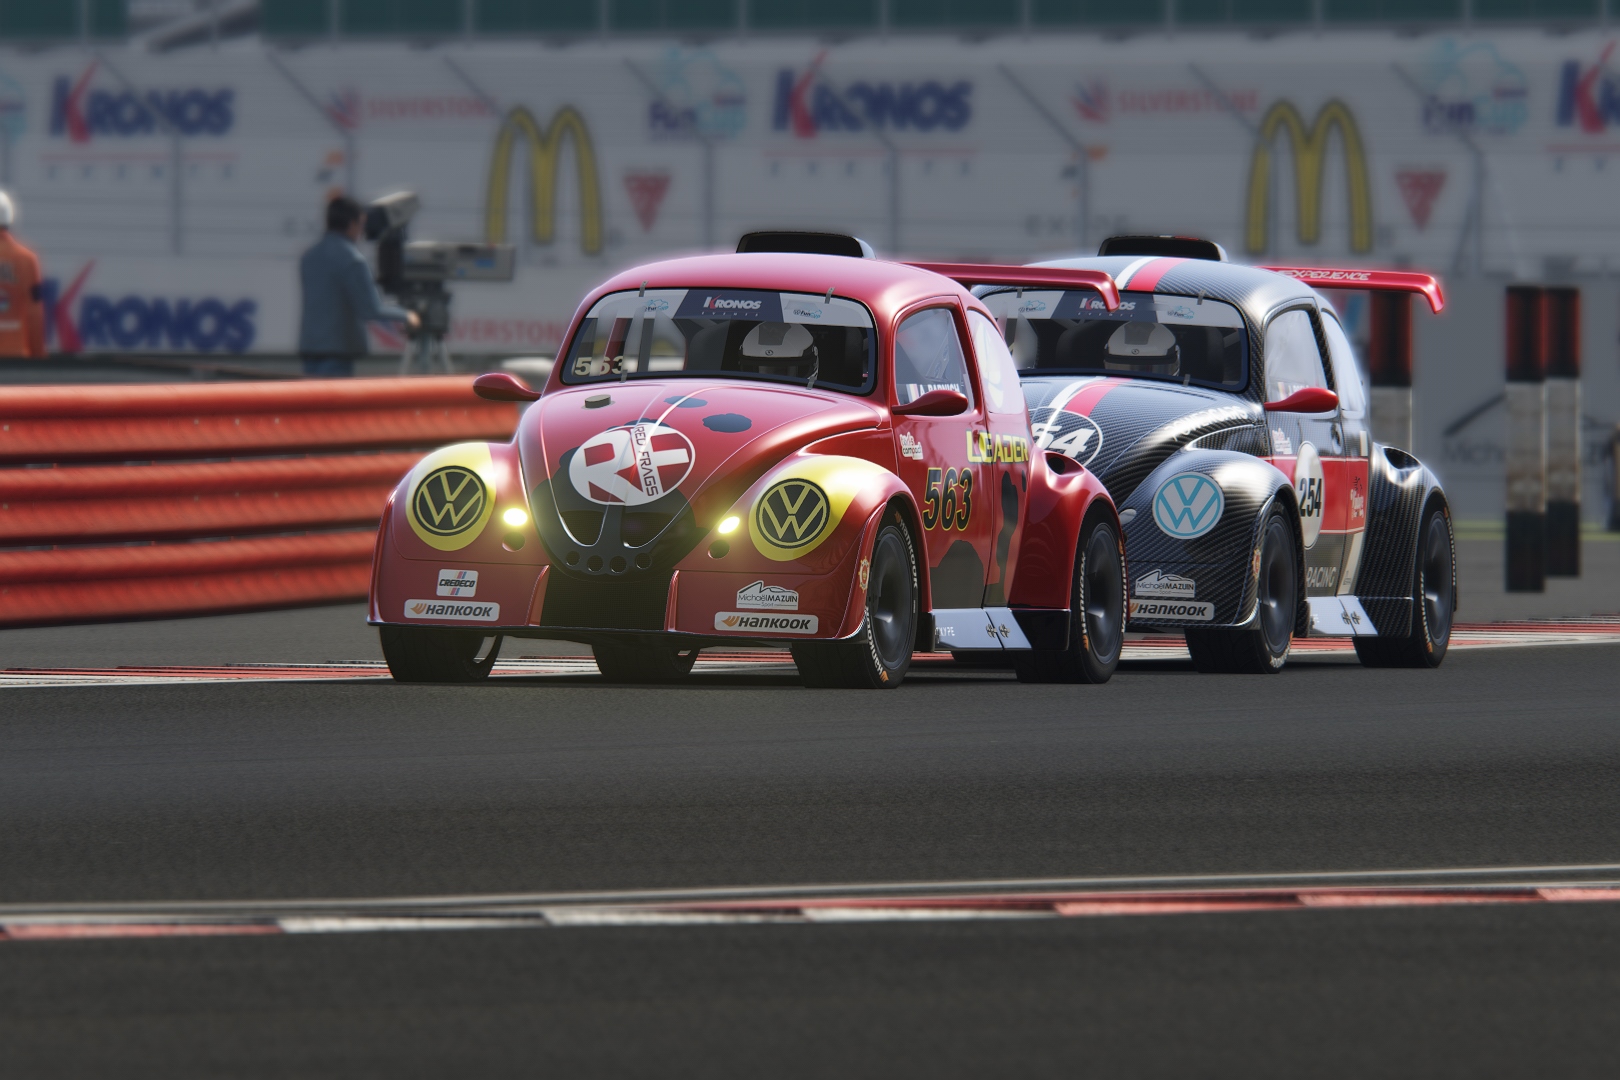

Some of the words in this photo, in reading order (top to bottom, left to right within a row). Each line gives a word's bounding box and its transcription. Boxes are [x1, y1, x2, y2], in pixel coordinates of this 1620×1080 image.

[772, 50, 974, 138] KRONOS
[43, 258, 258, 353] KRONOS
[703, 294, 762, 310] KRONOS
[1079, 296, 1136, 311] KROOS
[966, 430, 1029, 464] LEADER
[1032, 422, 1096, 458] 54
[922, 467, 973, 531] 563
[1299, 478, 1323, 518] 254
[439, 578, 476, 588] CREDECO
[1306, 566, 1336, 588] RACING
